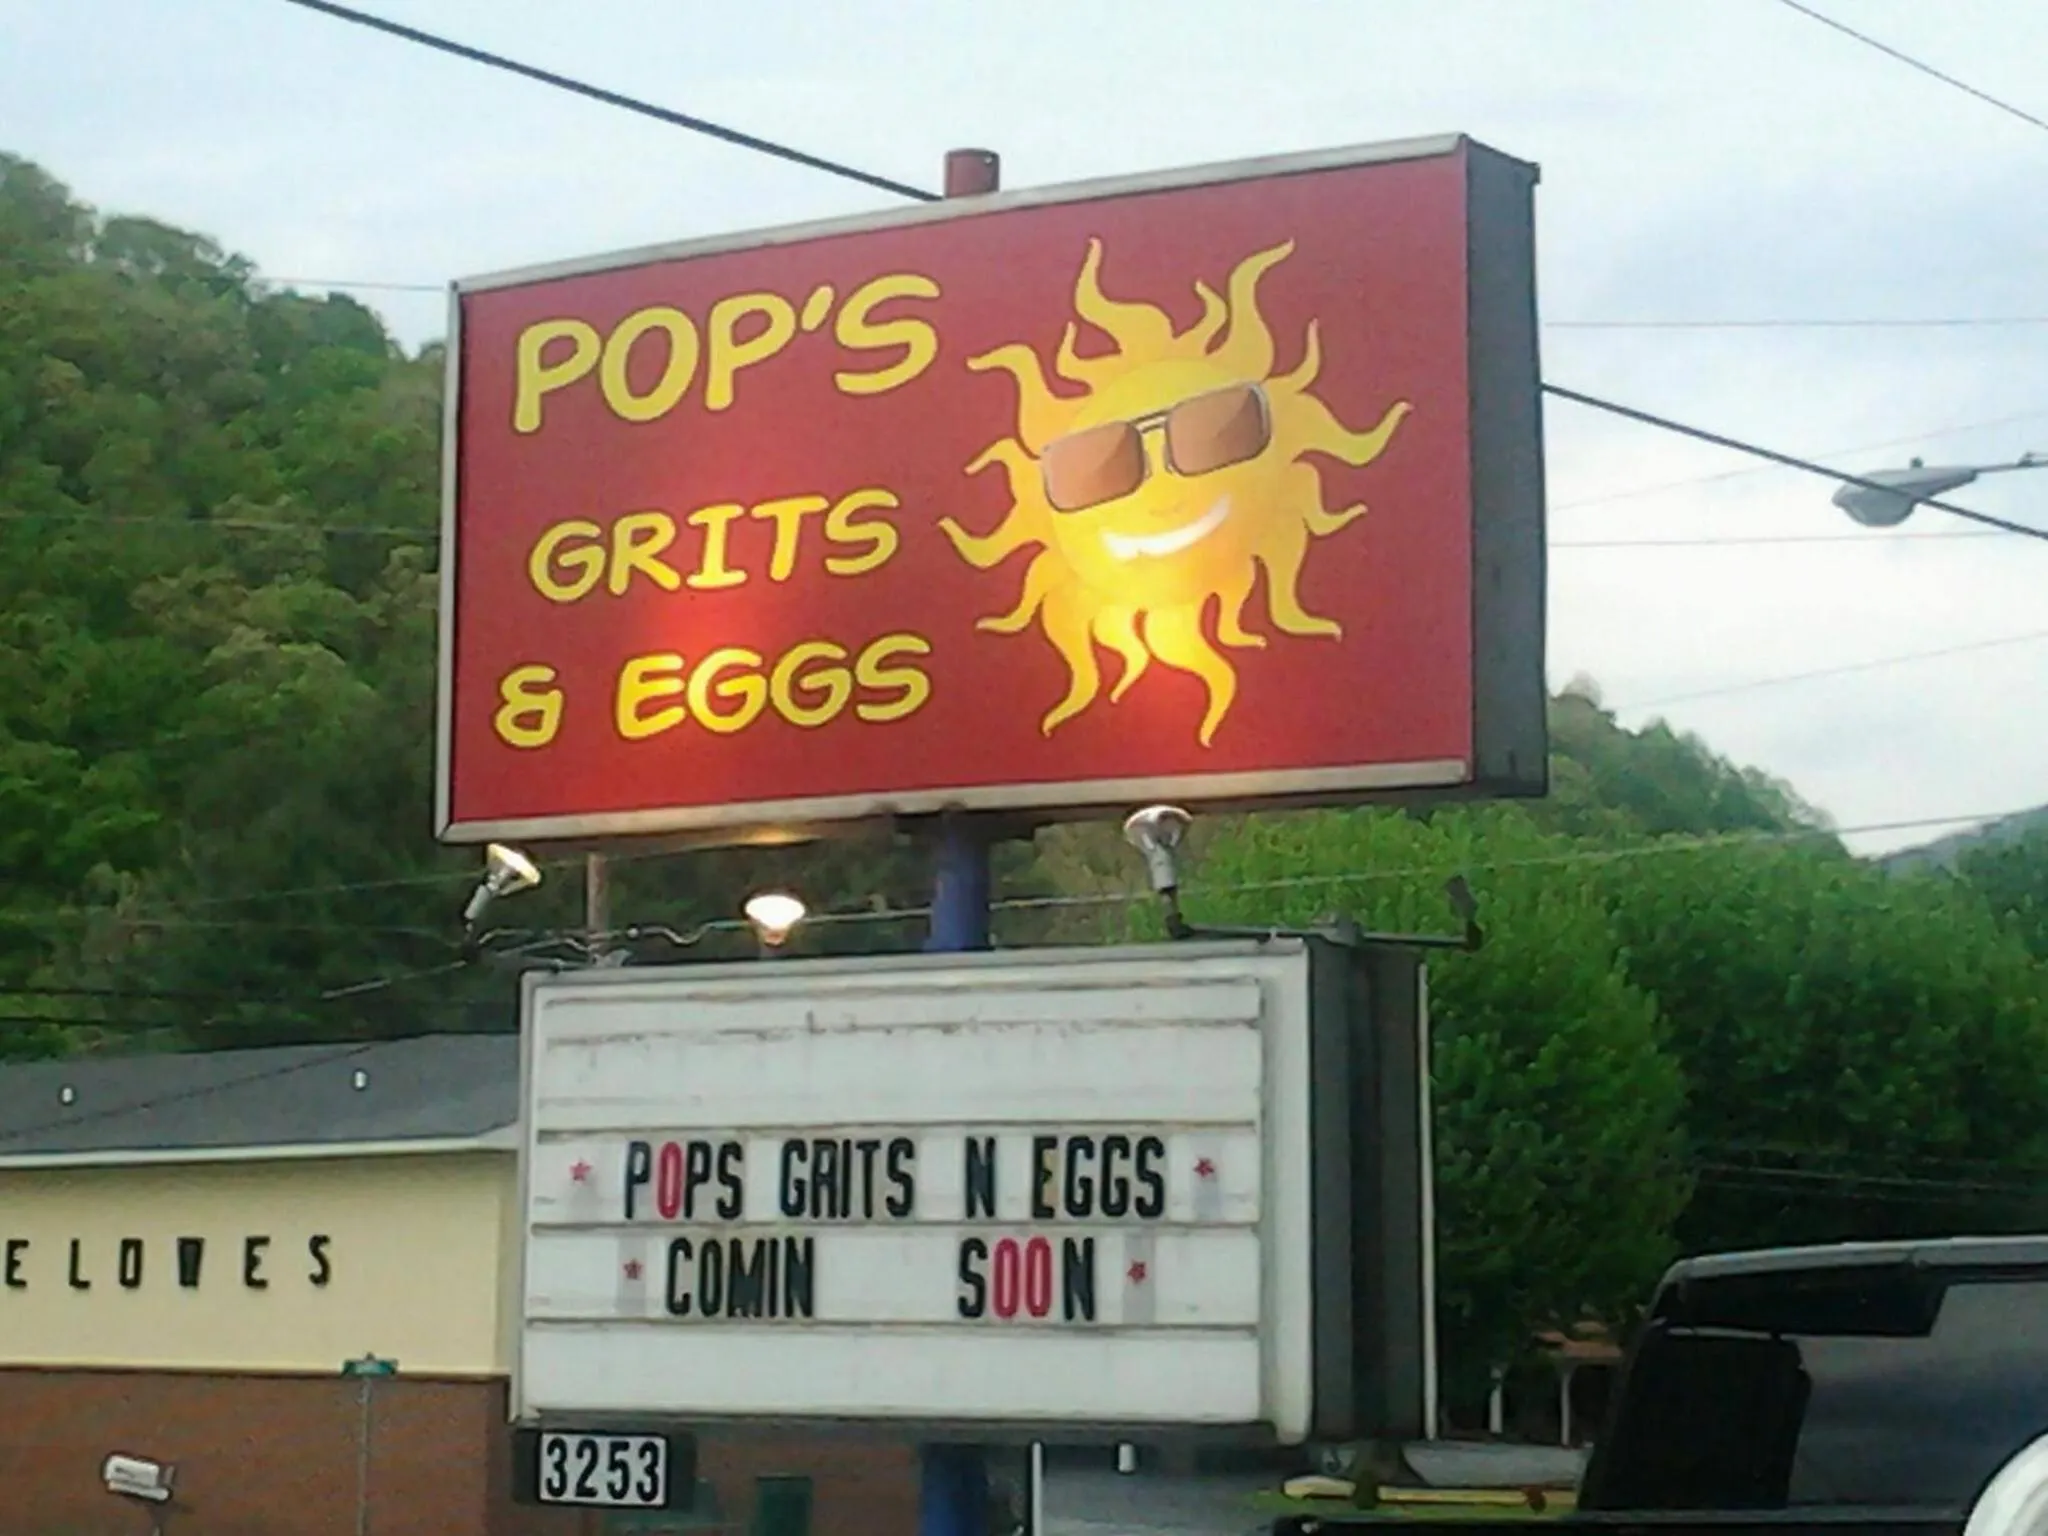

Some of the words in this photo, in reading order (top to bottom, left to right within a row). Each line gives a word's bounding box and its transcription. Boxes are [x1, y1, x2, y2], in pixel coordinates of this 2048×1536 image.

[512, 272, 941, 434] POP'S
[528, 487, 900, 604] GRITS
[493, 664, 564, 749] &
[615, 632, 932, 741] EGGS
[624, 1140, 744, 1220] POPS
[780, 1137, 915, 1219] GRITS
[965, 1136, 996, 1219] N
[1032, 1135, 1165, 1219] EGGS
[666, 1236, 814, 1318] COMIN
[958, 1236, 1095, 1321] SOON
[546, 1437, 660, 1503] 3253
